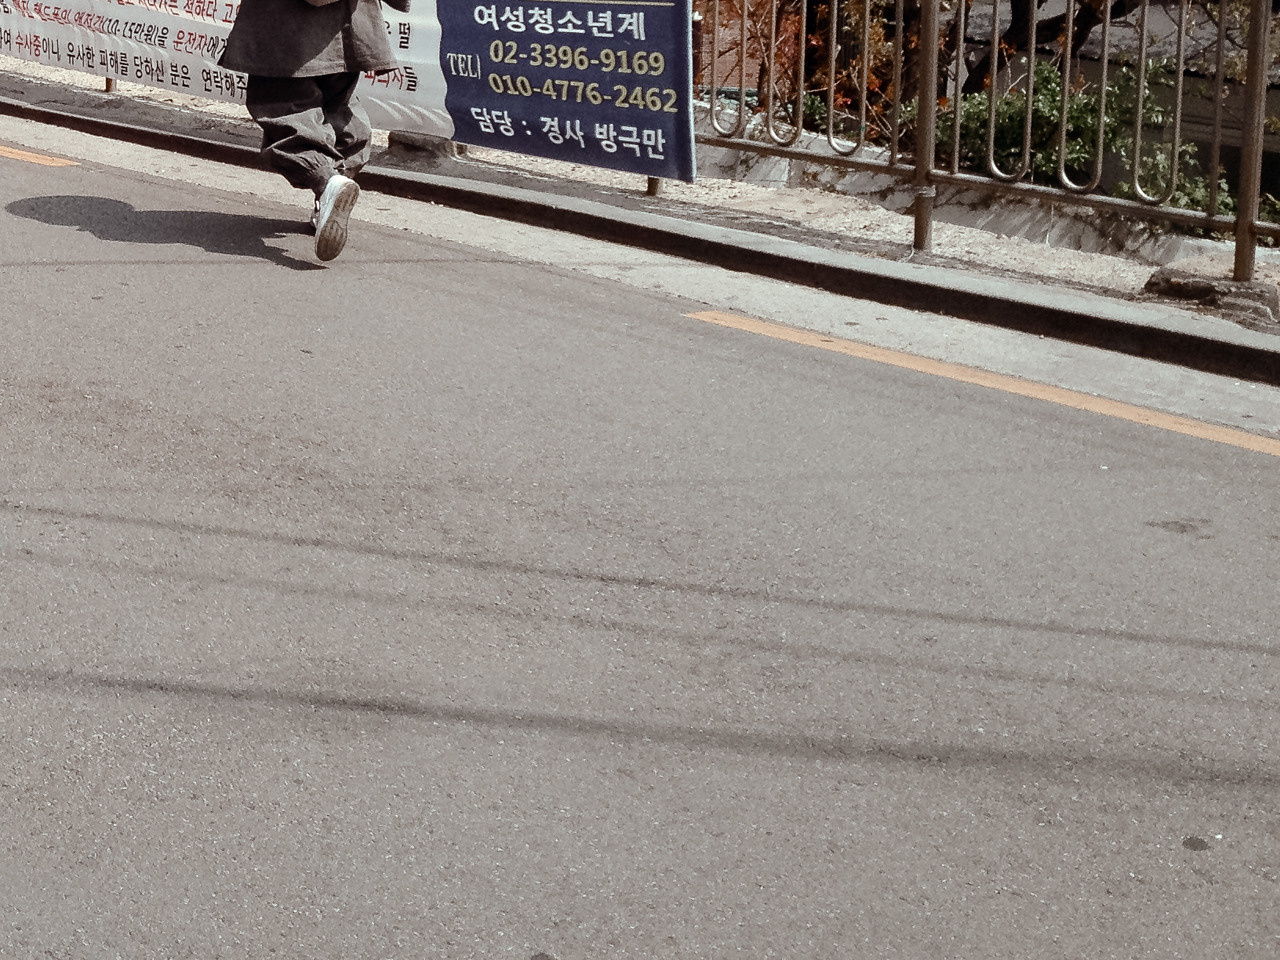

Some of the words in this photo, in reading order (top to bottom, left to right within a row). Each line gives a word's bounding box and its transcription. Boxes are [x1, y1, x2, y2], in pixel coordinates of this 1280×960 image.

[473, 5, 646, 41] 여성청소년계
[66, 42, 96, 69] 유사한
[99, 49, 130, 77] 피해를
[133, 56, 164, 82] 당하신
[170, 63, 191, 88] 분은
[447, 52, 482, 80] TEL)
[489, 40, 666, 76] 02-3396-9169
[488, 73, 679, 113] 010-4776-2462
[540, 116, 586, 148] 경사
[594, 123, 666, 160] 방극만
